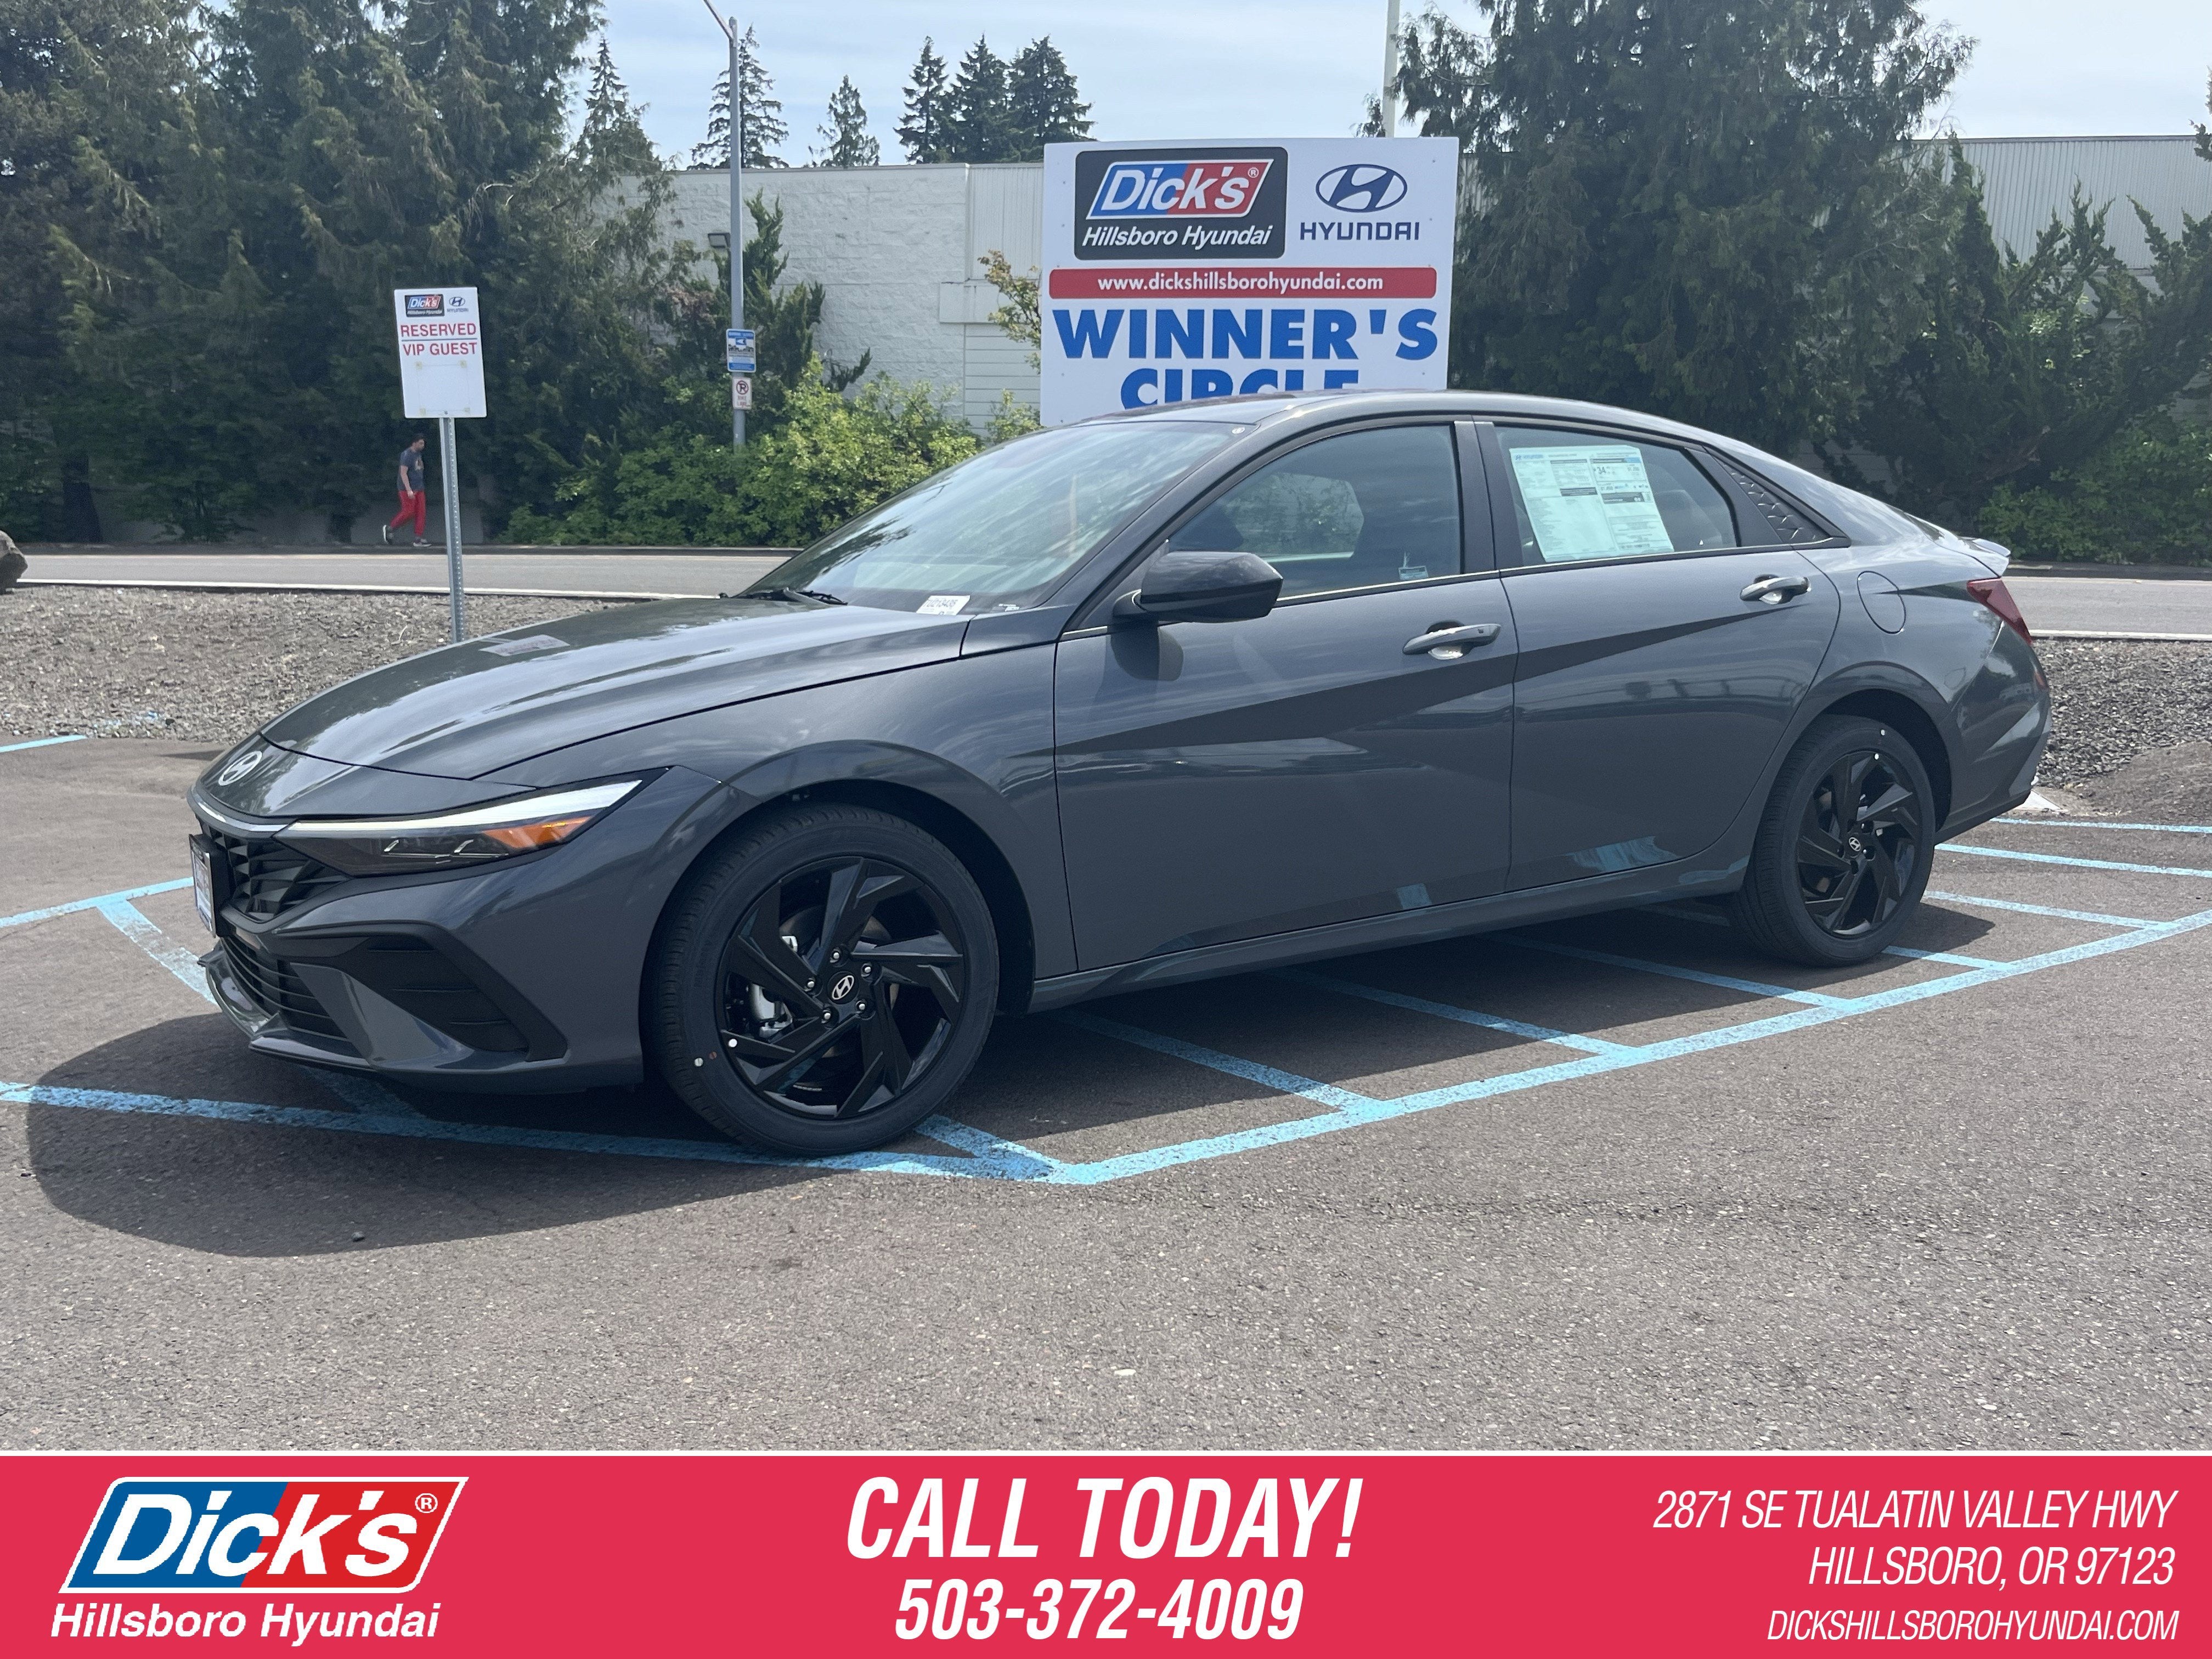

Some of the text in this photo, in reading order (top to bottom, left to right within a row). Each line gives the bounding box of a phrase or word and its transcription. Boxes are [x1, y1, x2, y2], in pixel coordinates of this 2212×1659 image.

[1082, 225, 1273, 250] Hillsboro Hyundai
[1300, 222, 1420, 240] HYUNDAI
[1098, 271, 1384, 295] www.dickshillsborohyundai.com
[400, 323, 477, 337] RESERVED
[1052, 308, 1438, 360] WINNER'S
[403, 342, 478, 356] VIP GUEST
